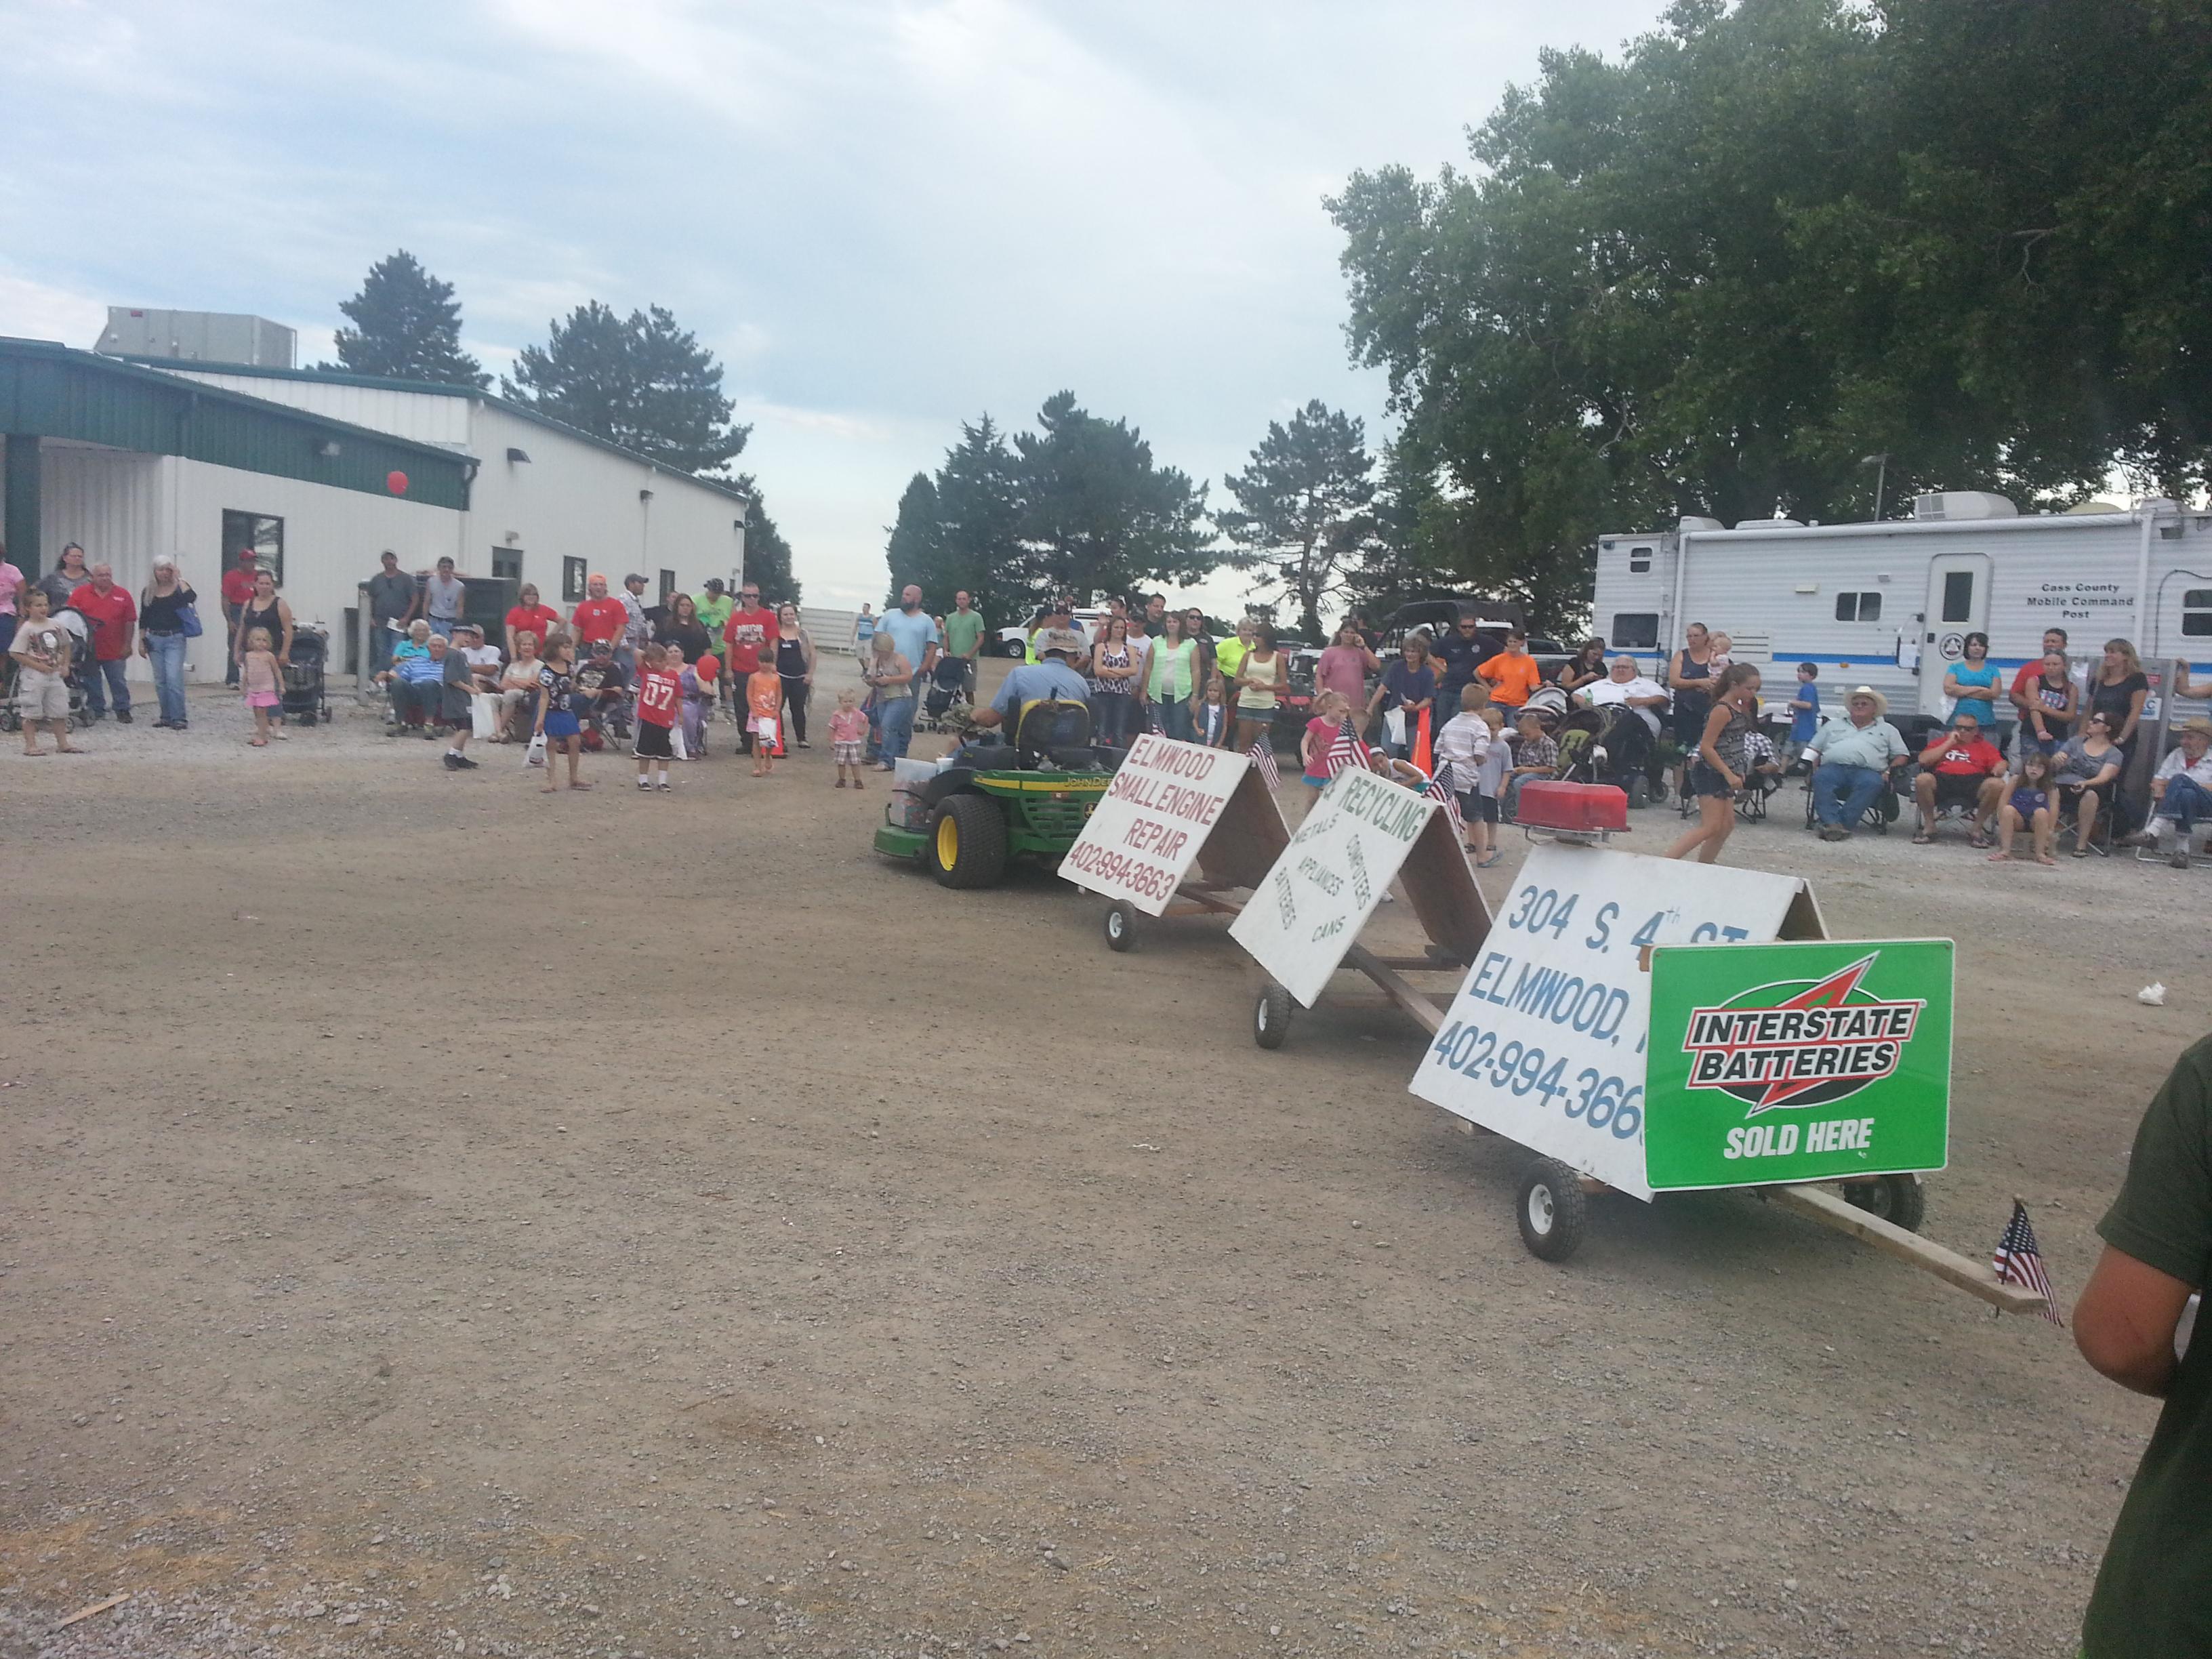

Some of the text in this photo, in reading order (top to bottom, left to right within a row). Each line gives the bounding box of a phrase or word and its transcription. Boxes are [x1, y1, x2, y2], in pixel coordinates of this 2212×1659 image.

[2028, 597, 2133, 606] Mobile Command
[2042, 583, 2120, 593] Cass County
[1130, 739, 1215, 781] ELMWOOD
[1108, 772, 1225, 825] SMALL ENGINE
[1338, 776, 1427, 842] RECYCLING
[1122, 819, 1188, 861] REPAIR
[1312, 916, 1346, 942] CANS
[1509, 886, 1579, 939] 304
[1586, 902, 1620, 954] S.
[1469, 952, 1629, 1048] ELMWOOD,
[1693, 1008, 1912, 1043] INTERSTATE
[1434, 1021, 1643, 1145] 402-994-366
[1698, 1044, 1894, 1080] BATTERIES
[1723, 1118, 1875, 1160] SOLD HERE
